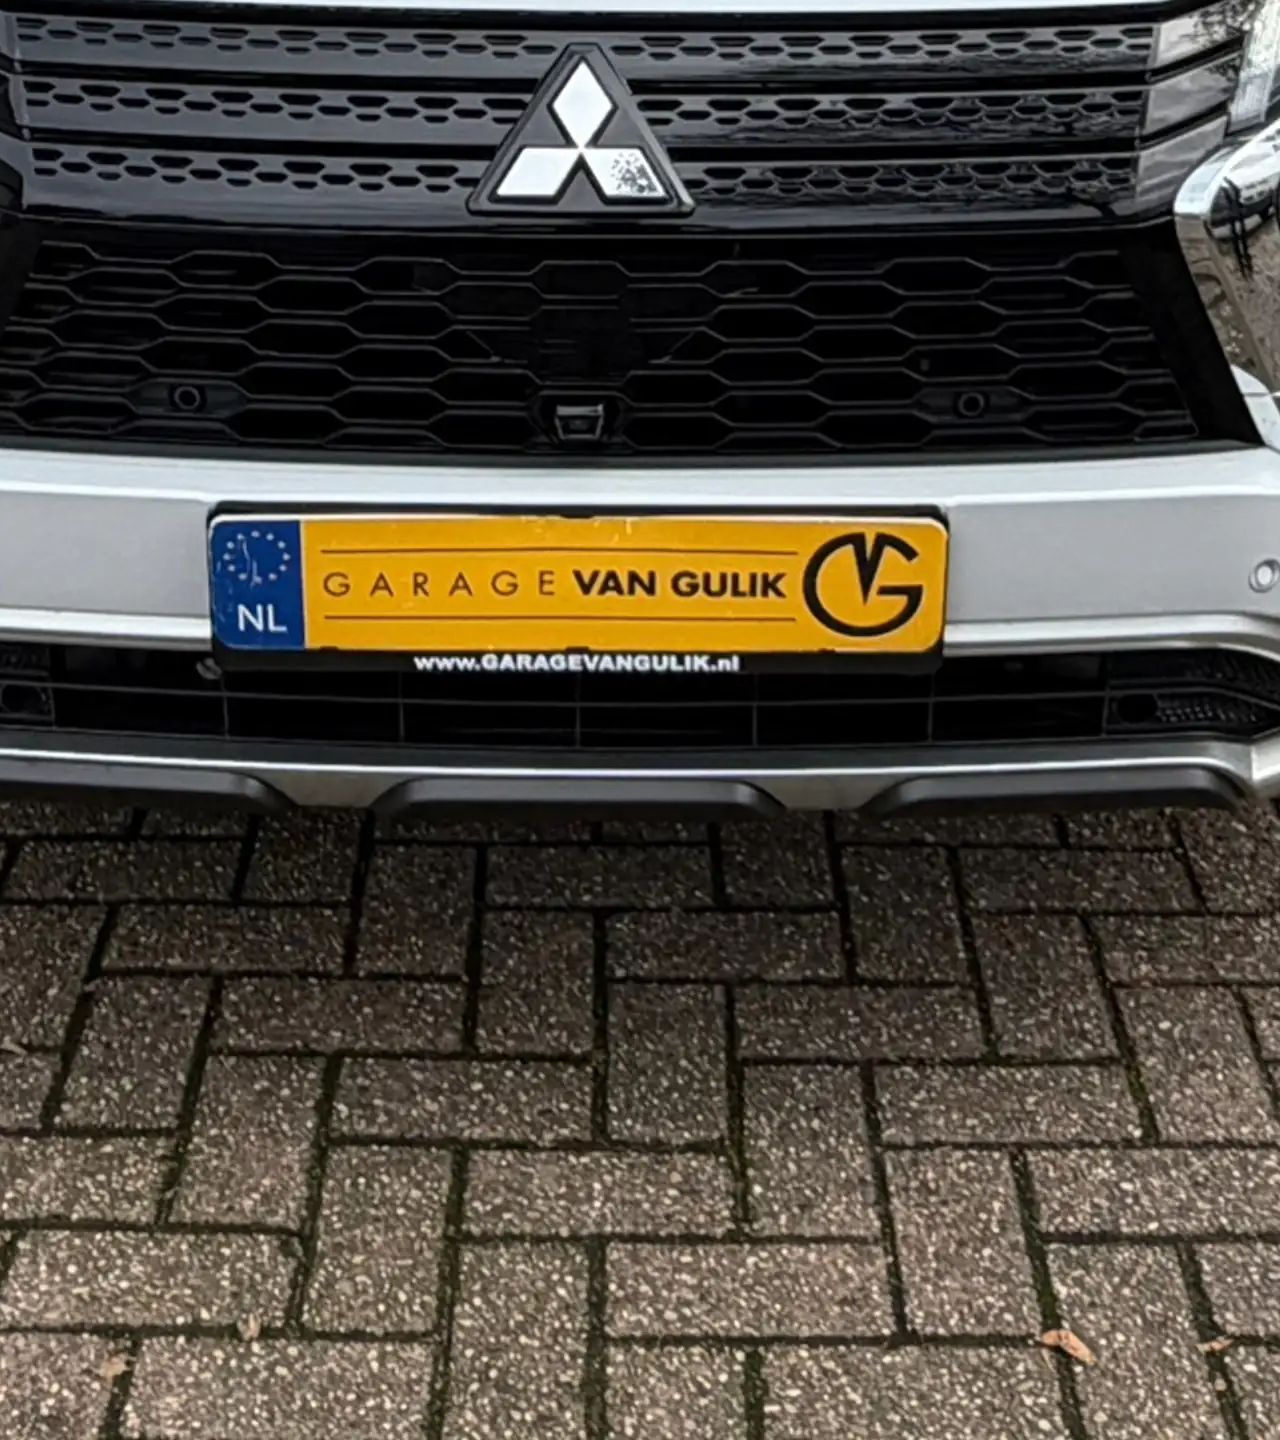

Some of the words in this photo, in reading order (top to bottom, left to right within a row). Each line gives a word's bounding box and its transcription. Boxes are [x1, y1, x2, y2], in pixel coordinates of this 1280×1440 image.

[322, 569, 556, 598] GARAGE
[572, 569, 658, 597] VAN
[670, 569, 788, 598] GULIK
[236, 603, 288, 633] NL
[413, 653, 741, 673] www.GARAGEVANGULIK.nl
